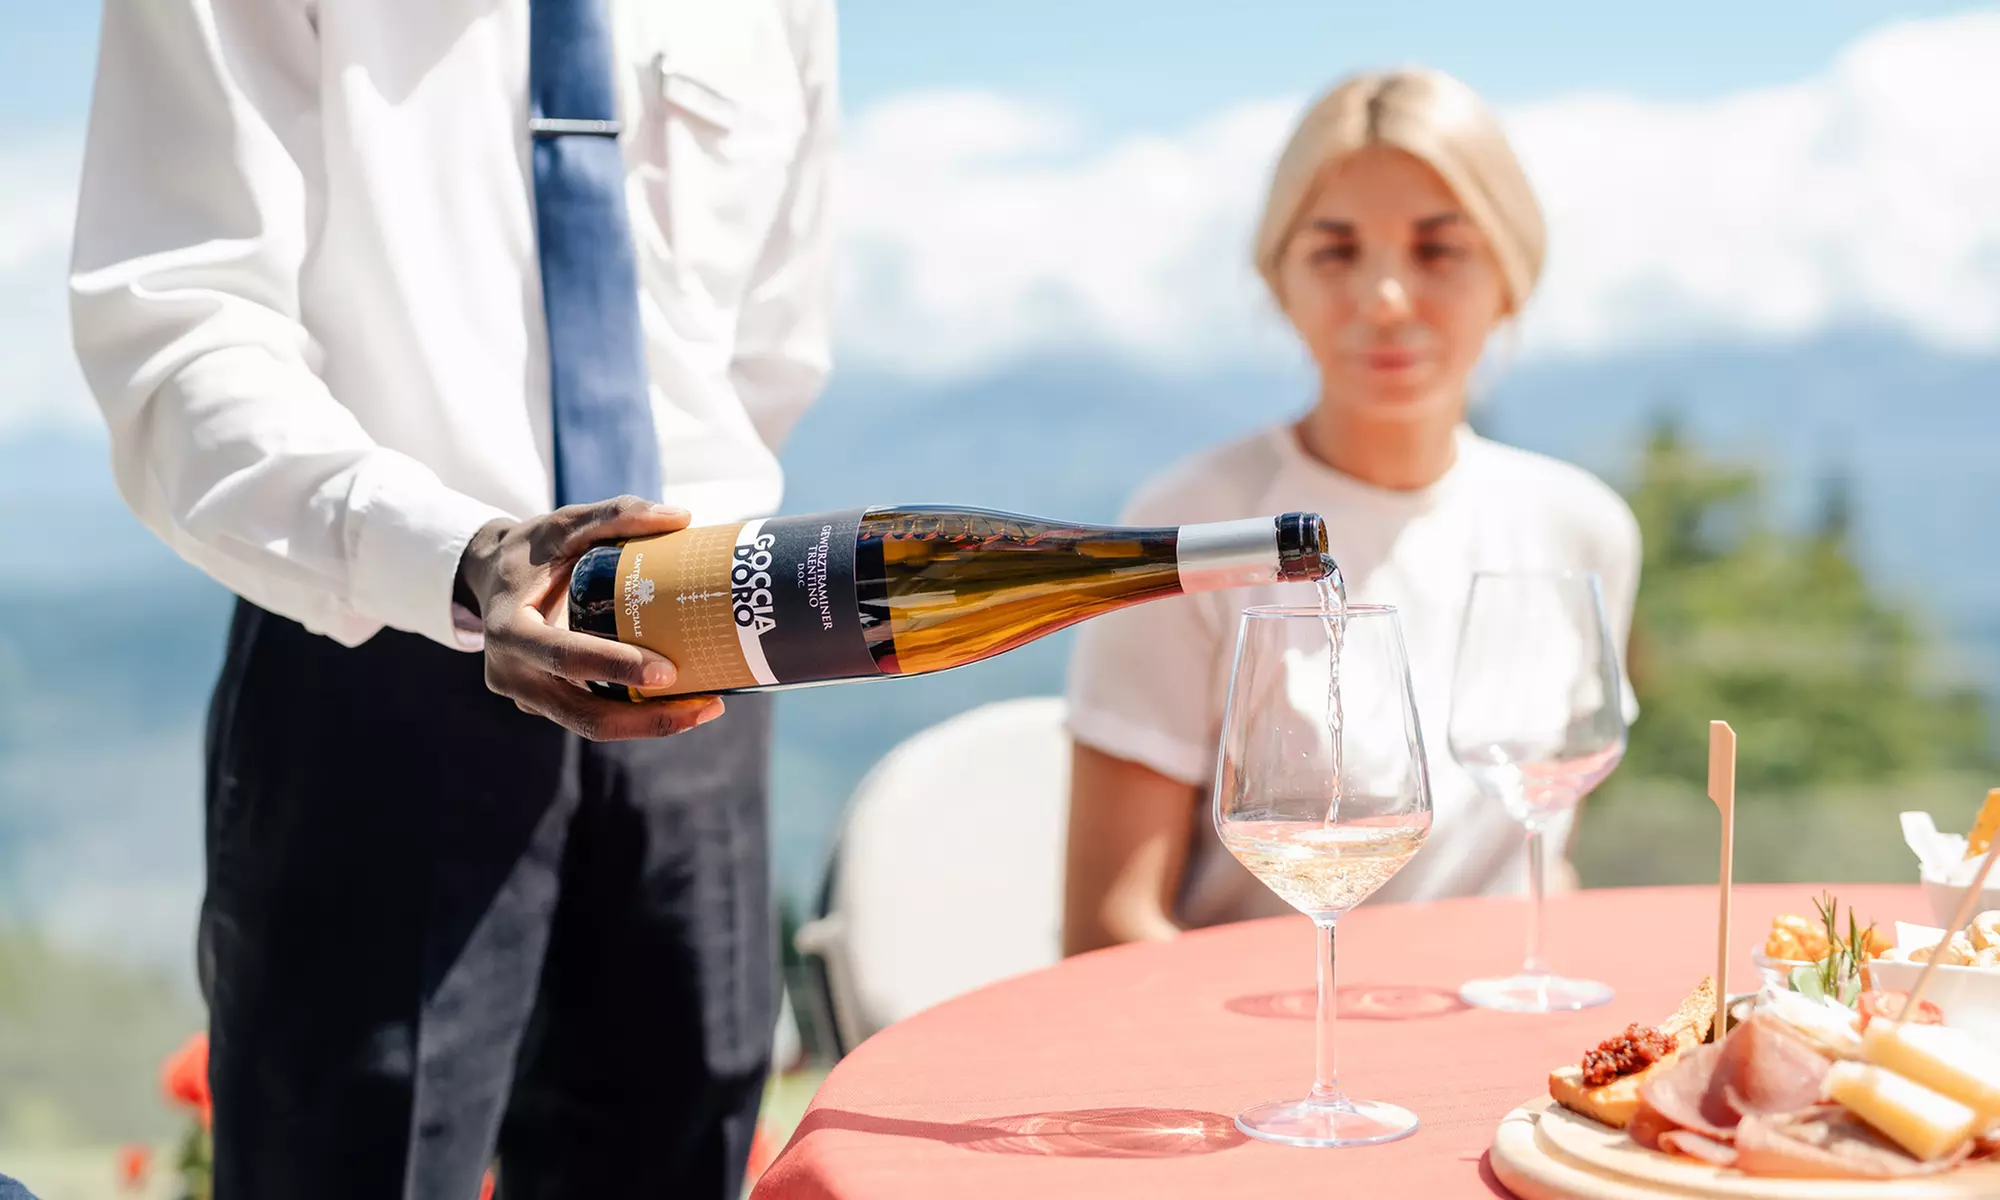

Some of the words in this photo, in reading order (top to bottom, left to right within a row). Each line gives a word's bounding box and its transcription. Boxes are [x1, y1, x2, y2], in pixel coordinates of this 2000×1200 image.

[624, 574, 633, 616] TRENTO
[632, 553, 643, 589] CANTINA
[731, 544, 756, 627] D'ORO
[750, 533, 777, 636] GOCCIA
[807, 544, 820, 608] TRENTINO
[817, 525, 833, 631] GEWÜRZTRAMINER
[631, 598, 643, 638] SOCIALE
